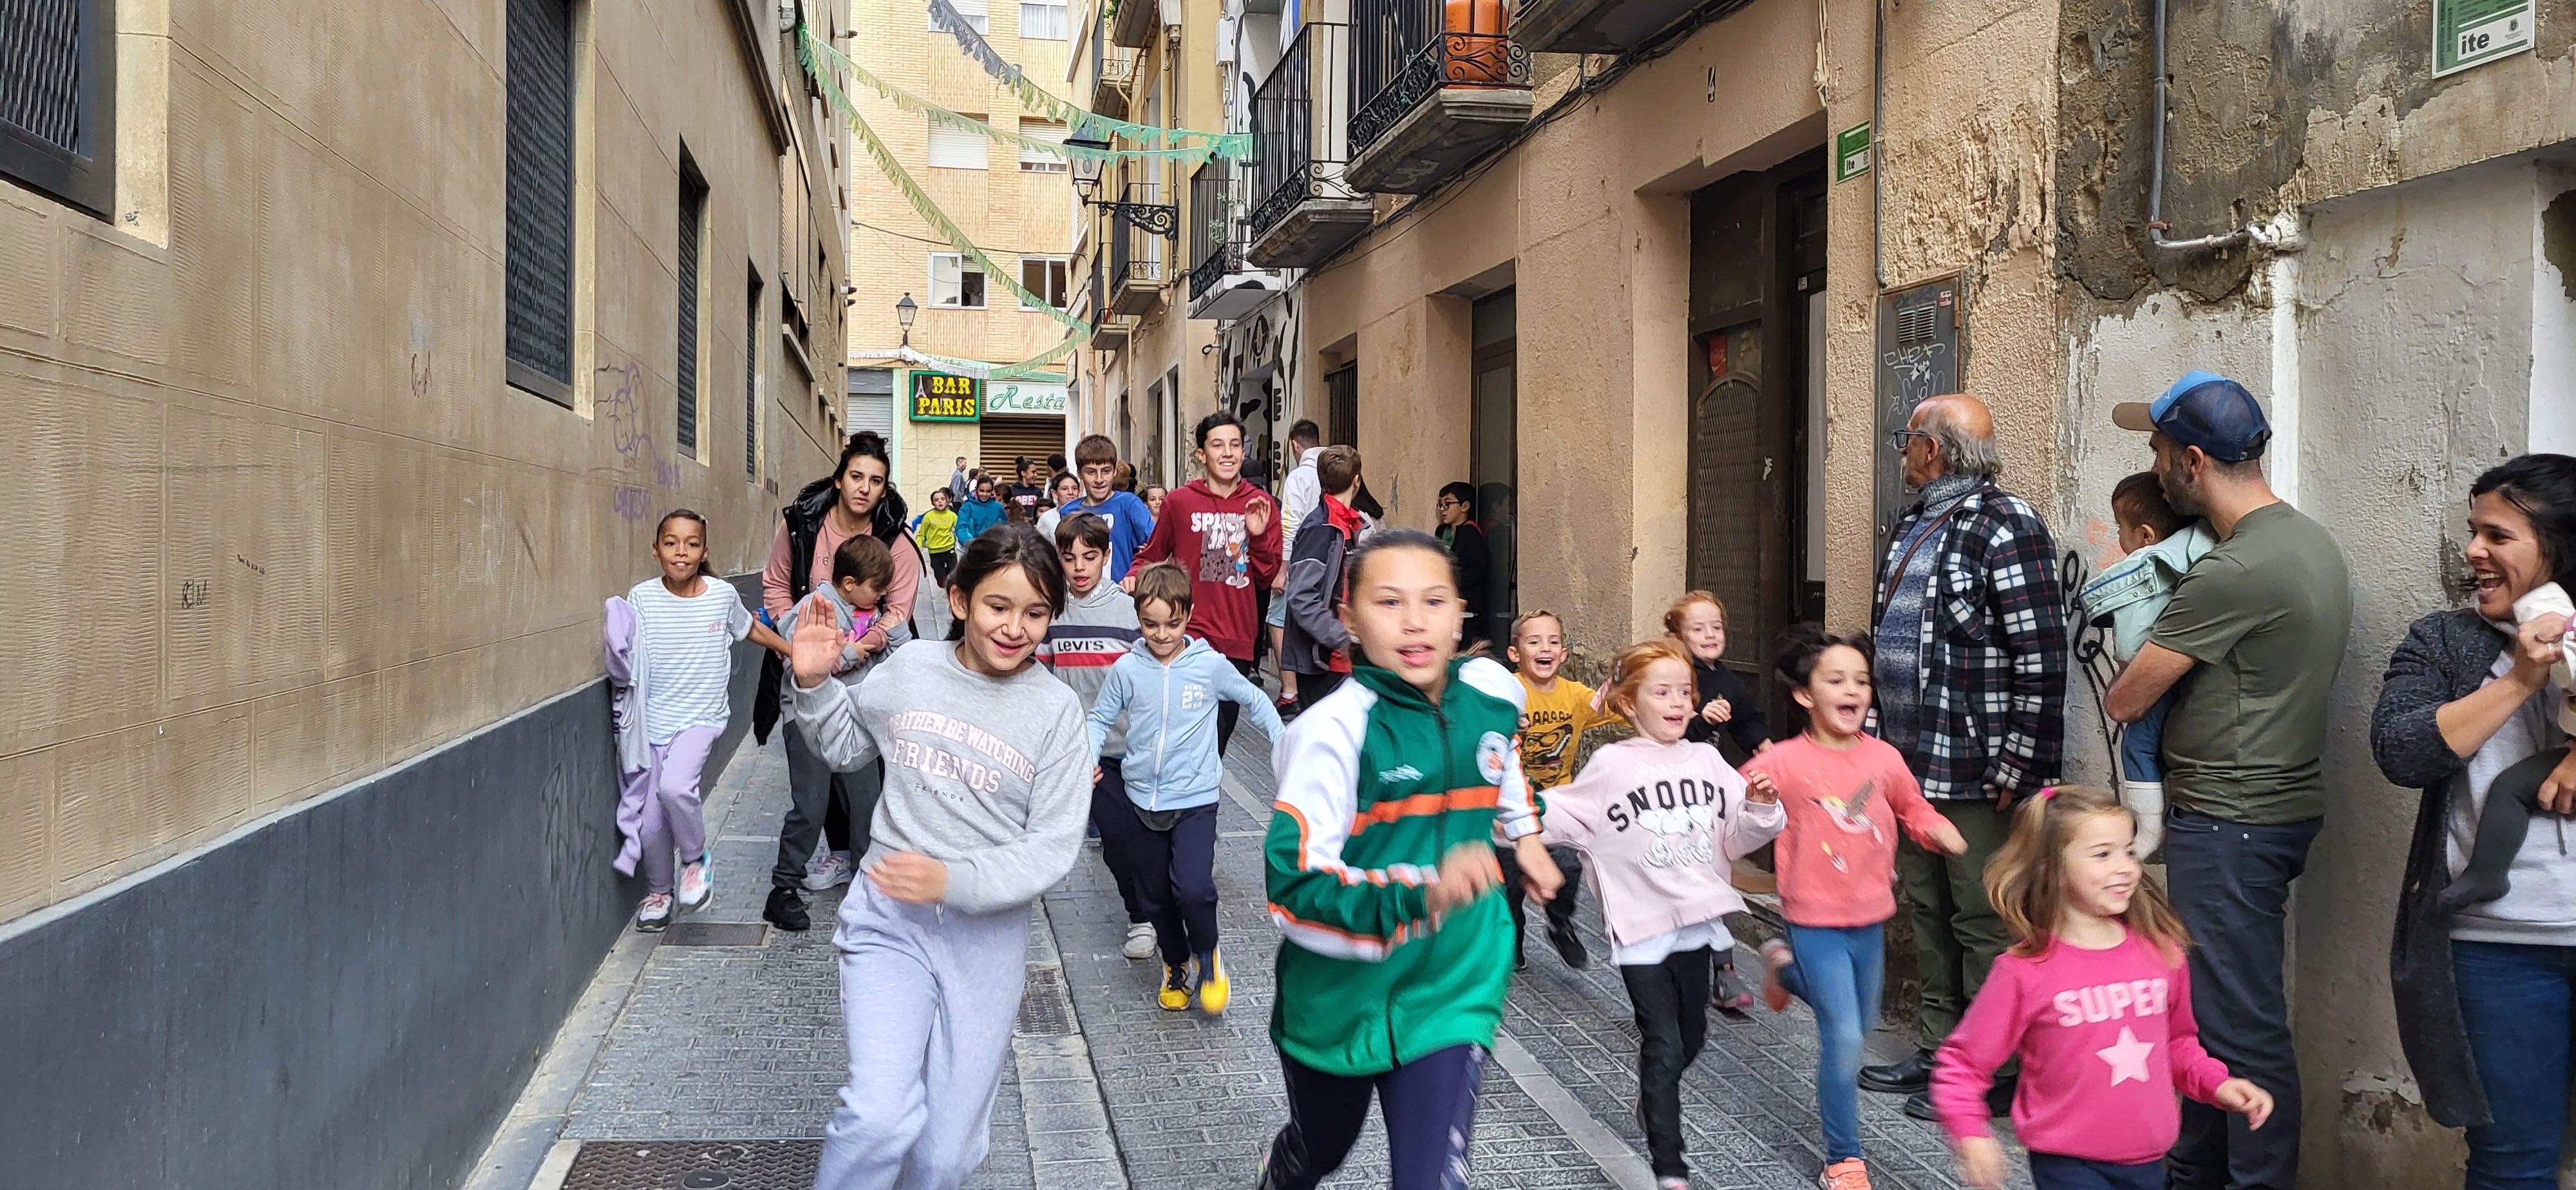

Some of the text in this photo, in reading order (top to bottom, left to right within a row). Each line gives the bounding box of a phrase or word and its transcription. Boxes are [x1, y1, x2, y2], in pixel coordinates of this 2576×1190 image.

[2461, 32, 2490, 55] ite
[1708, 66, 1715, 102] 4
[931, 376, 971, 395] BAR
[989, 384, 1066, 411] Resta
[918, 397, 976, 416] PARIS
[891, 738, 1003, 793] FRIENDS
[943, 717, 968, 743] BE
[967, 723, 1036, 784] WATCHING
[2053, 978, 2169, 1027] SUPER
